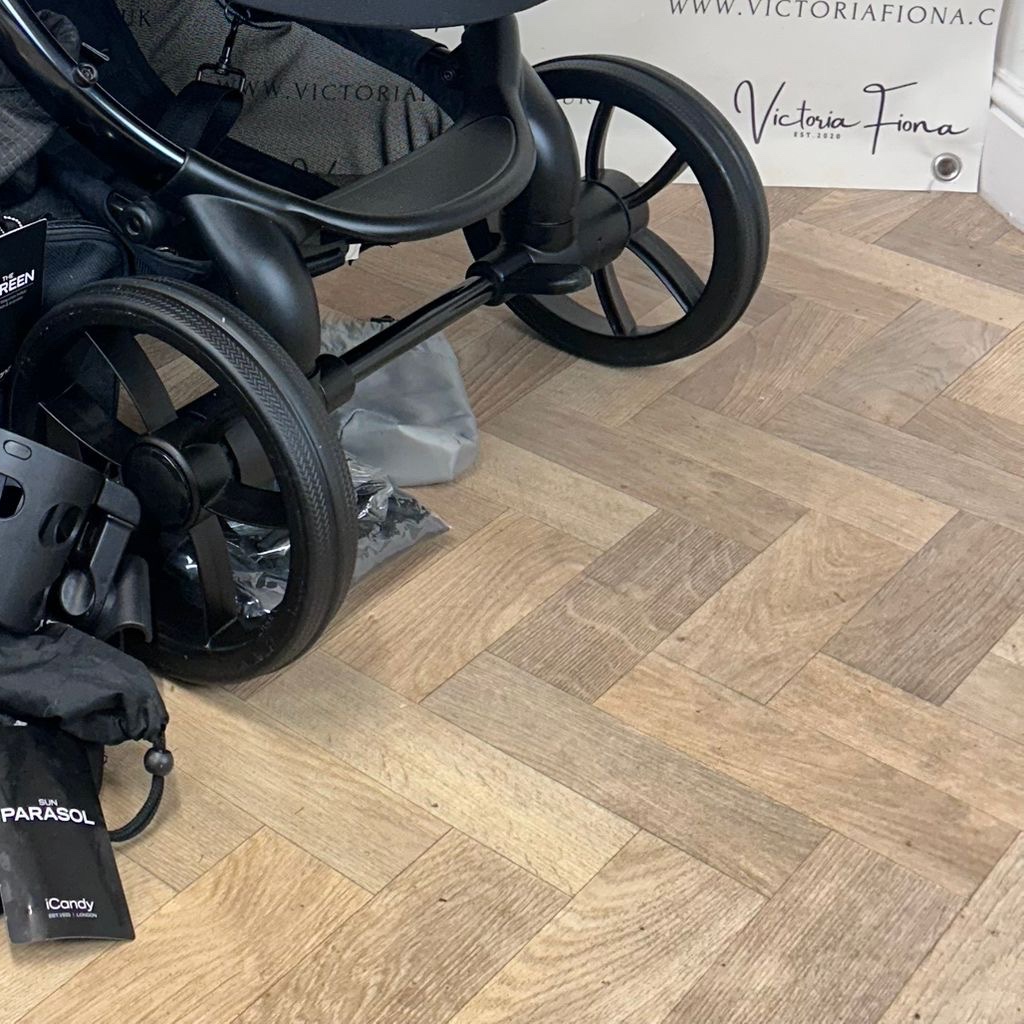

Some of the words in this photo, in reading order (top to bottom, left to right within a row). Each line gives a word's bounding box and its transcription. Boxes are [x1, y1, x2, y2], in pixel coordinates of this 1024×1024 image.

[734, 80, 861, 145] Victoria
[863, 82, 969, 156] Fiona
[2, 272, 14, 282] THE
[38, 798, 58, 807] SUN
[0, 806, 96, 826] PARASOL
[45, 897, 94, 912] iCandy
